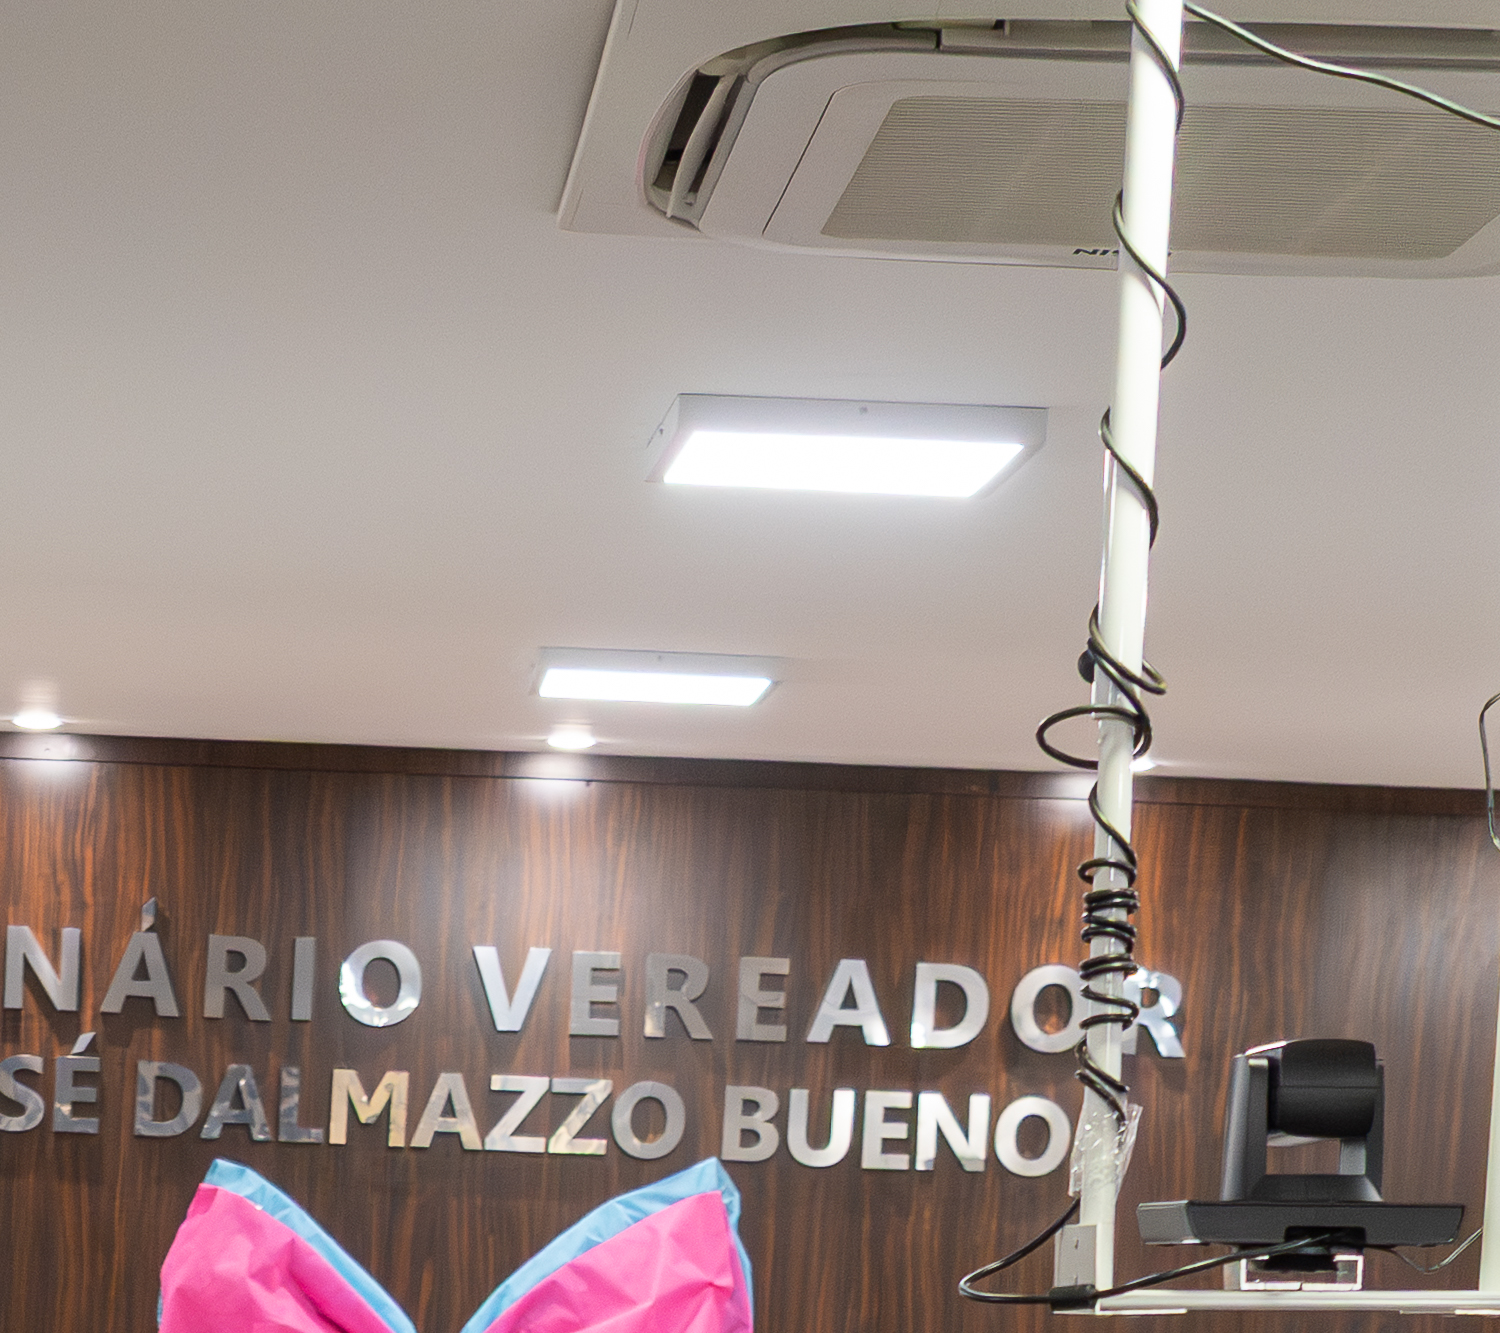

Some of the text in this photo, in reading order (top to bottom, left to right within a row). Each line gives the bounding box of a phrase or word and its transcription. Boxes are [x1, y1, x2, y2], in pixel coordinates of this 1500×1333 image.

[472, 945, 1186, 1058] VEREADOR
[134, 1060, 686, 1160] DALMAZZO
[720, 1085, 1072, 1177] BUENO
